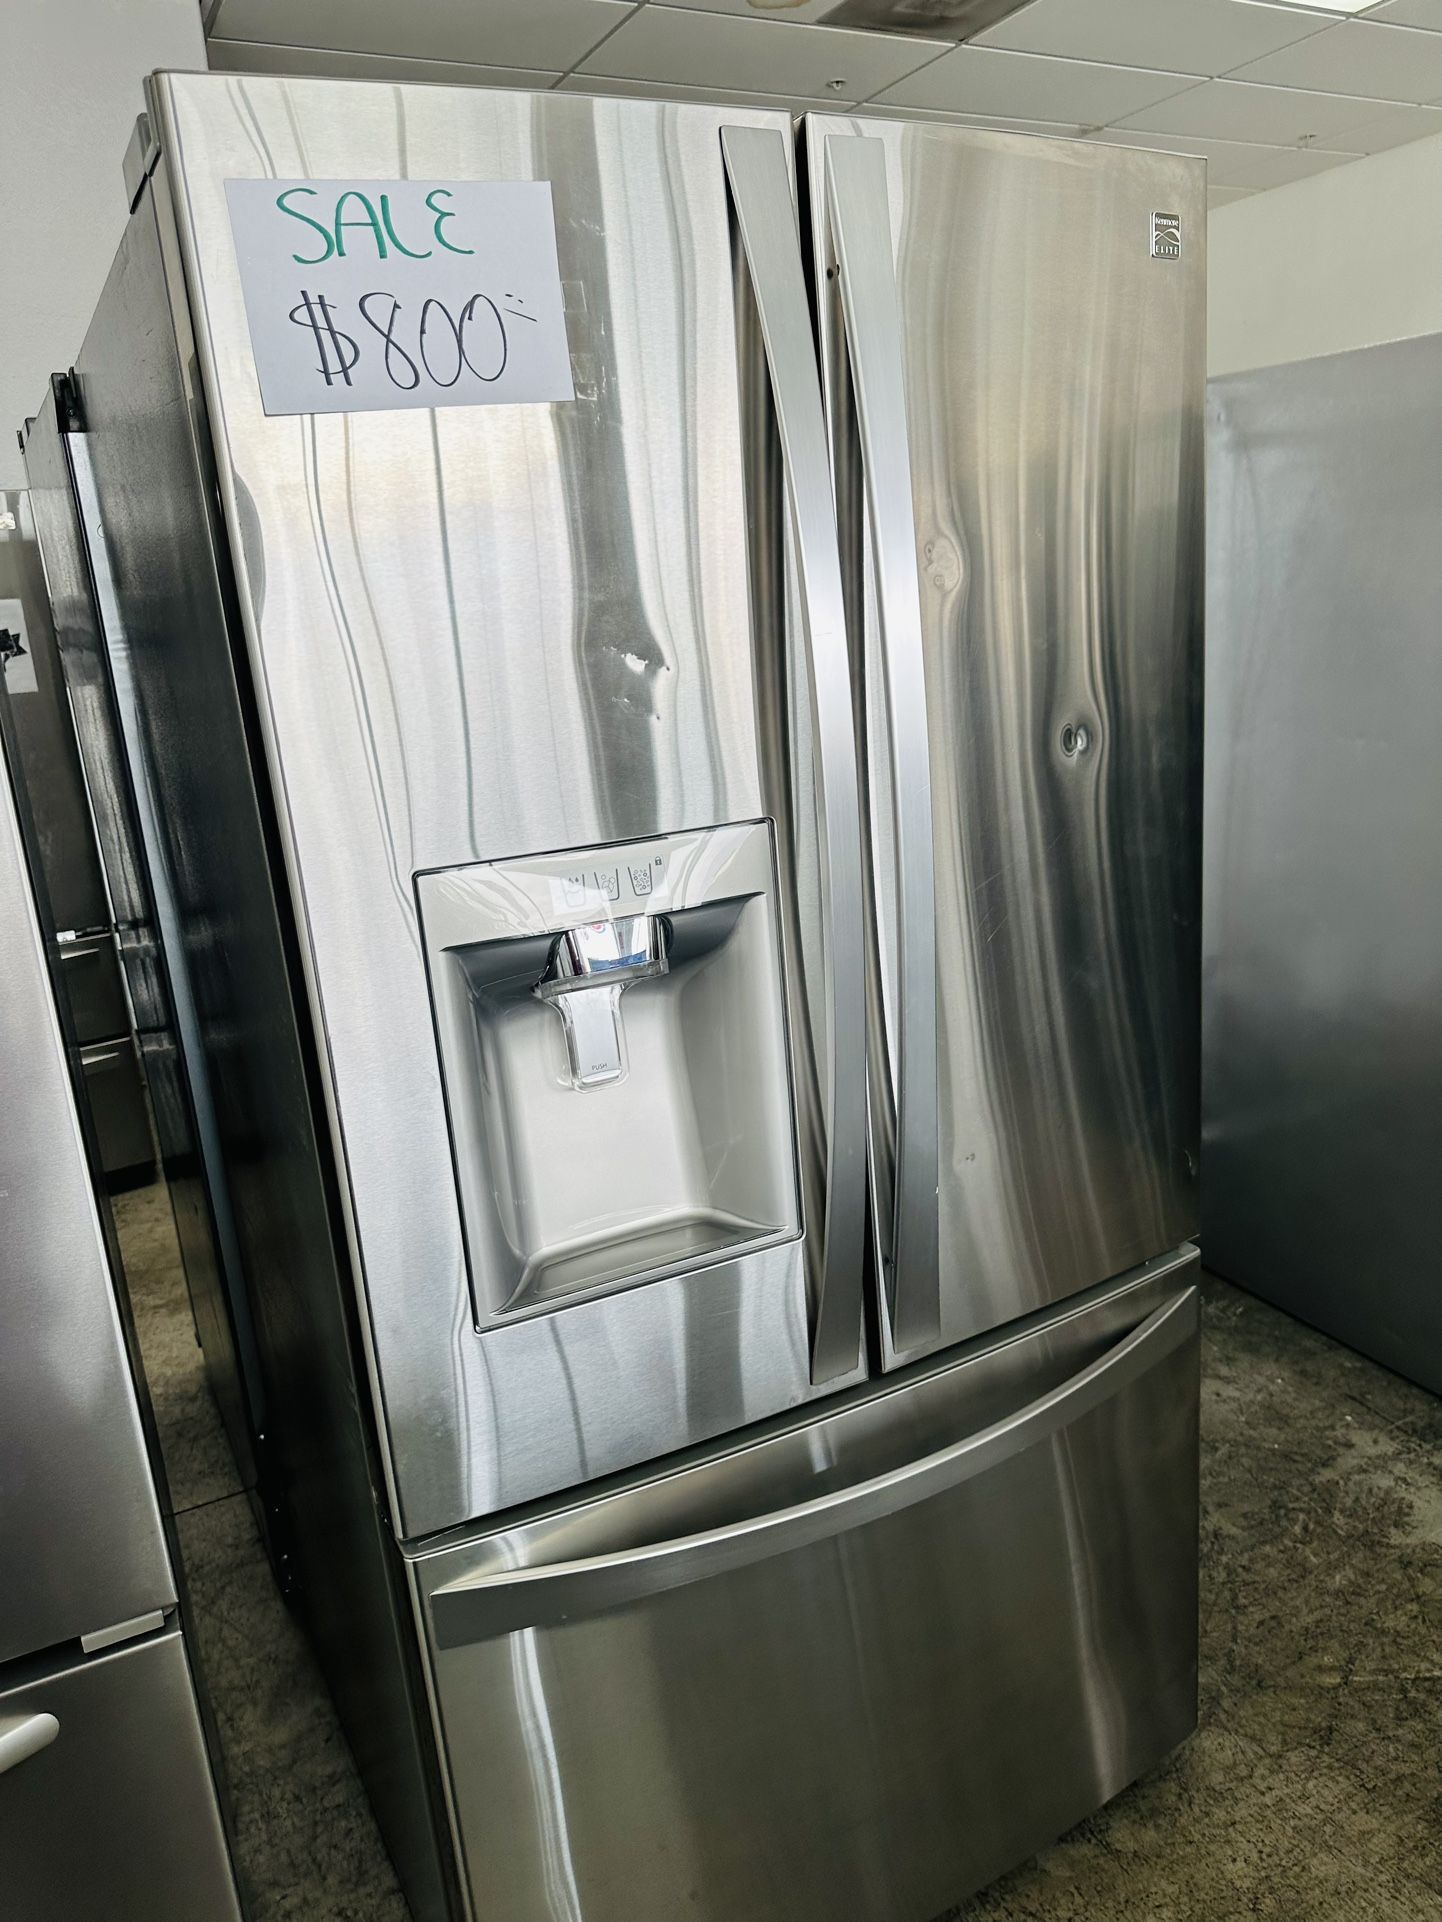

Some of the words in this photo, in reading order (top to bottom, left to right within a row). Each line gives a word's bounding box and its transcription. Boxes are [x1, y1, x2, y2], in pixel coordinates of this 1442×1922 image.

[275, 187, 476, 265] SALE
[1155, 244, 1179, 255] ELITE
[591, 1062, 608, 1072] PUSH
